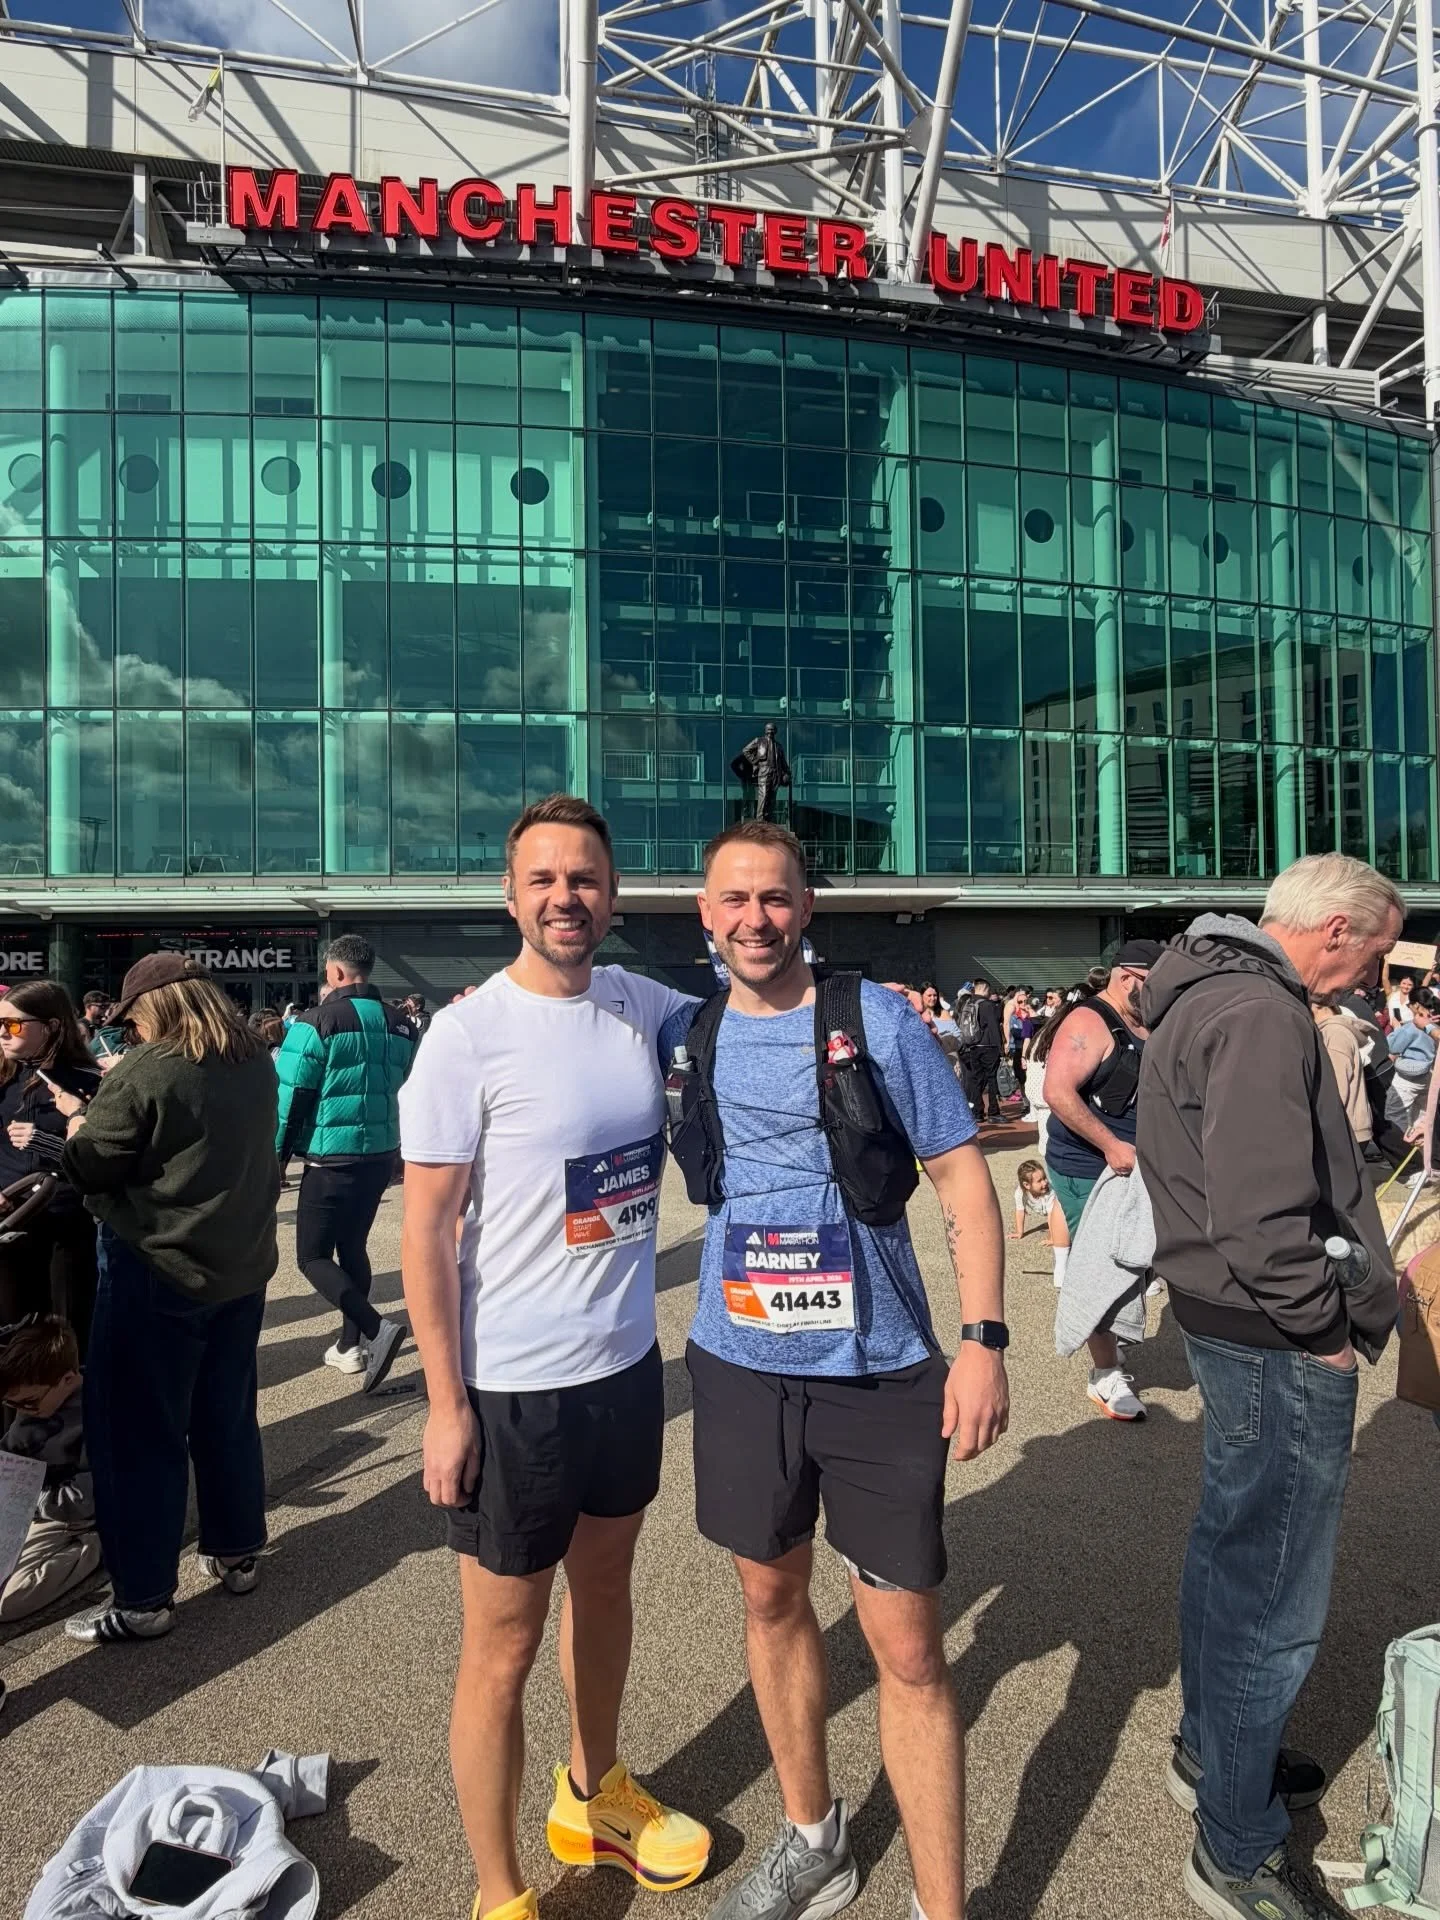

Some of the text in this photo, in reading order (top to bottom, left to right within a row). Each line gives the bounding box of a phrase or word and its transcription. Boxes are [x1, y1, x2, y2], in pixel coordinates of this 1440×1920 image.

[228, 166, 1204, 335] MANCHESTER UNITED
[158, 949, 292, 968] TRANCE
[598, 1165, 650, 1193] JAMES
[572, 1215, 601, 1225] ORANGE
[618, 1196, 657, 1225] 4199
[746, 1251, 820, 1269] BARNEY
[770, 1290, 842, 1312] 41443
